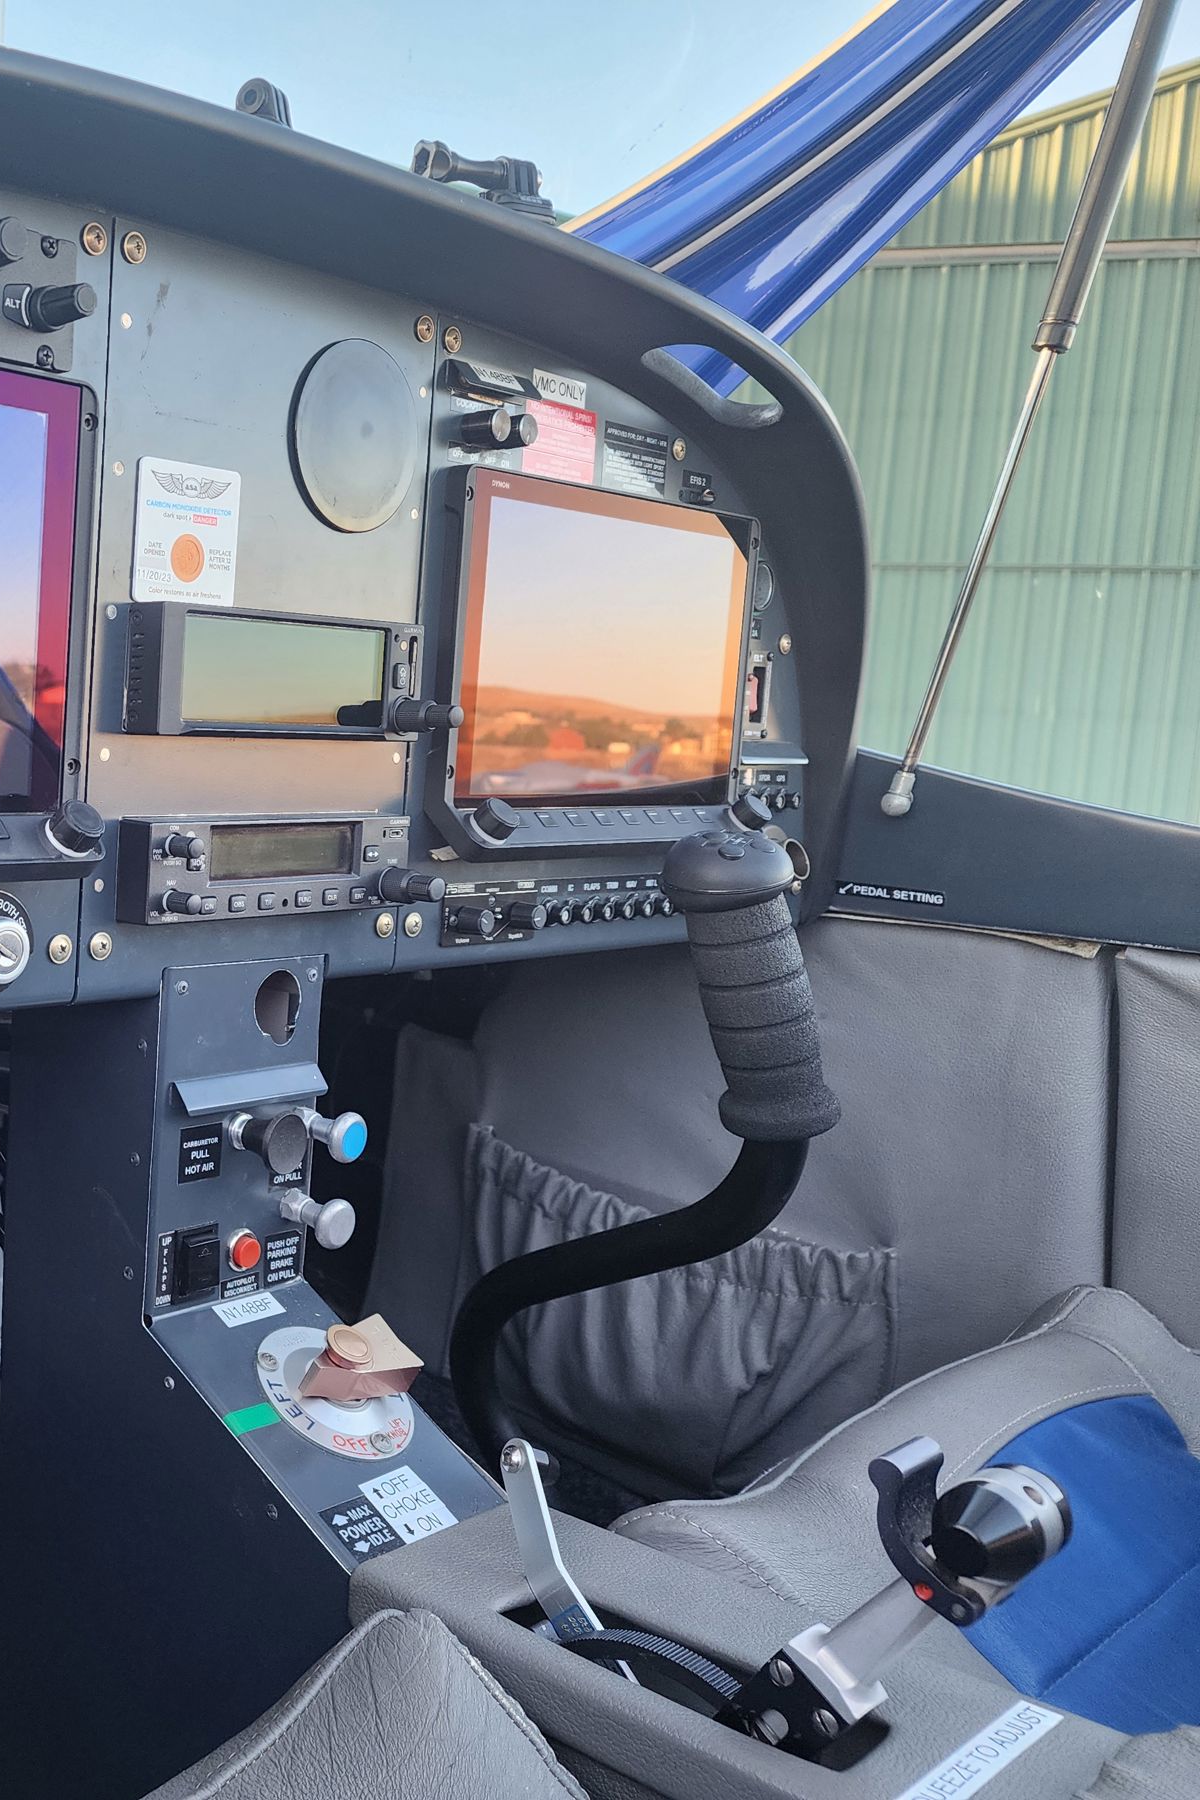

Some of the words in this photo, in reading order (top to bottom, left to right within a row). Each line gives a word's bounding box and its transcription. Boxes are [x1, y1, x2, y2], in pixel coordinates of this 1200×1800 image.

[5, 298, 21, 309] ALT
[535, 374, 557, 393] VMC
[558, 382, 585, 401] ONLY
[690, 475, 701, 485] EFIS
[146, 500, 170, 509] CARBON
[203, 507, 231, 516] DETECTOR
[144, 548, 165, 557] OPENED
[209, 549, 231, 557] REPLACE
[138, 568, 171, 582] 11/20/23
[164, 588, 184, 597] restores
[584, 882, 600, 891] FLAPS
[298, 896, 311, 904] FUNC
[853, 884, 891, 898] PEDAL
[892, 890, 944, 905] SETTING
[183, 1136, 219, 1149] CARBURETOR
[191, 1149, 210, 1160] PULL
[185, 1163, 200, 1176] HOT
[201, 1162, 215, 1173] AIR
[274, 1176, 284, 1185] ON
[285, 1172, 302, 1183] PULL
[162, 1236, 172, 1246] UP
[267, 1239, 285, 1250] PUSH
[286, 1236, 300, 1247] OFF
[267, 1246, 297, 1260] PARKING
[161, 1249, 169, 1292] FLAPS
[270, 1258, 294, 1270] BRAKE
[226, 1275, 256, 1289] AUTOPILOT
[267, 1273, 278, 1283] ON
[278, 1268, 296, 1280] PULL
[224, 1283, 258, 1298] DISCONNECT
[155, 1294, 172, 1305] DOWN
[222, 1297, 272, 1320] N148BF
[266, 1378, 315, 1430] LEFT
[388, 1418, 405, 1429] LIFT
[333, 1434, 368, 1451] OFF
[380, 1474, 411, 1496] OFF
[383, 1489, 436, 1520] CHOKE
[347, 1504, 374, 1522] MAX
[416, 1512, 443, 1532] ON
[339, 1517, 387, 1542] POWER
[368, 1529, 395, 1548] IDLE
[967, 1743, 1000, 1764] TO
[988, 1706, 1048, 1750] ADJUST
